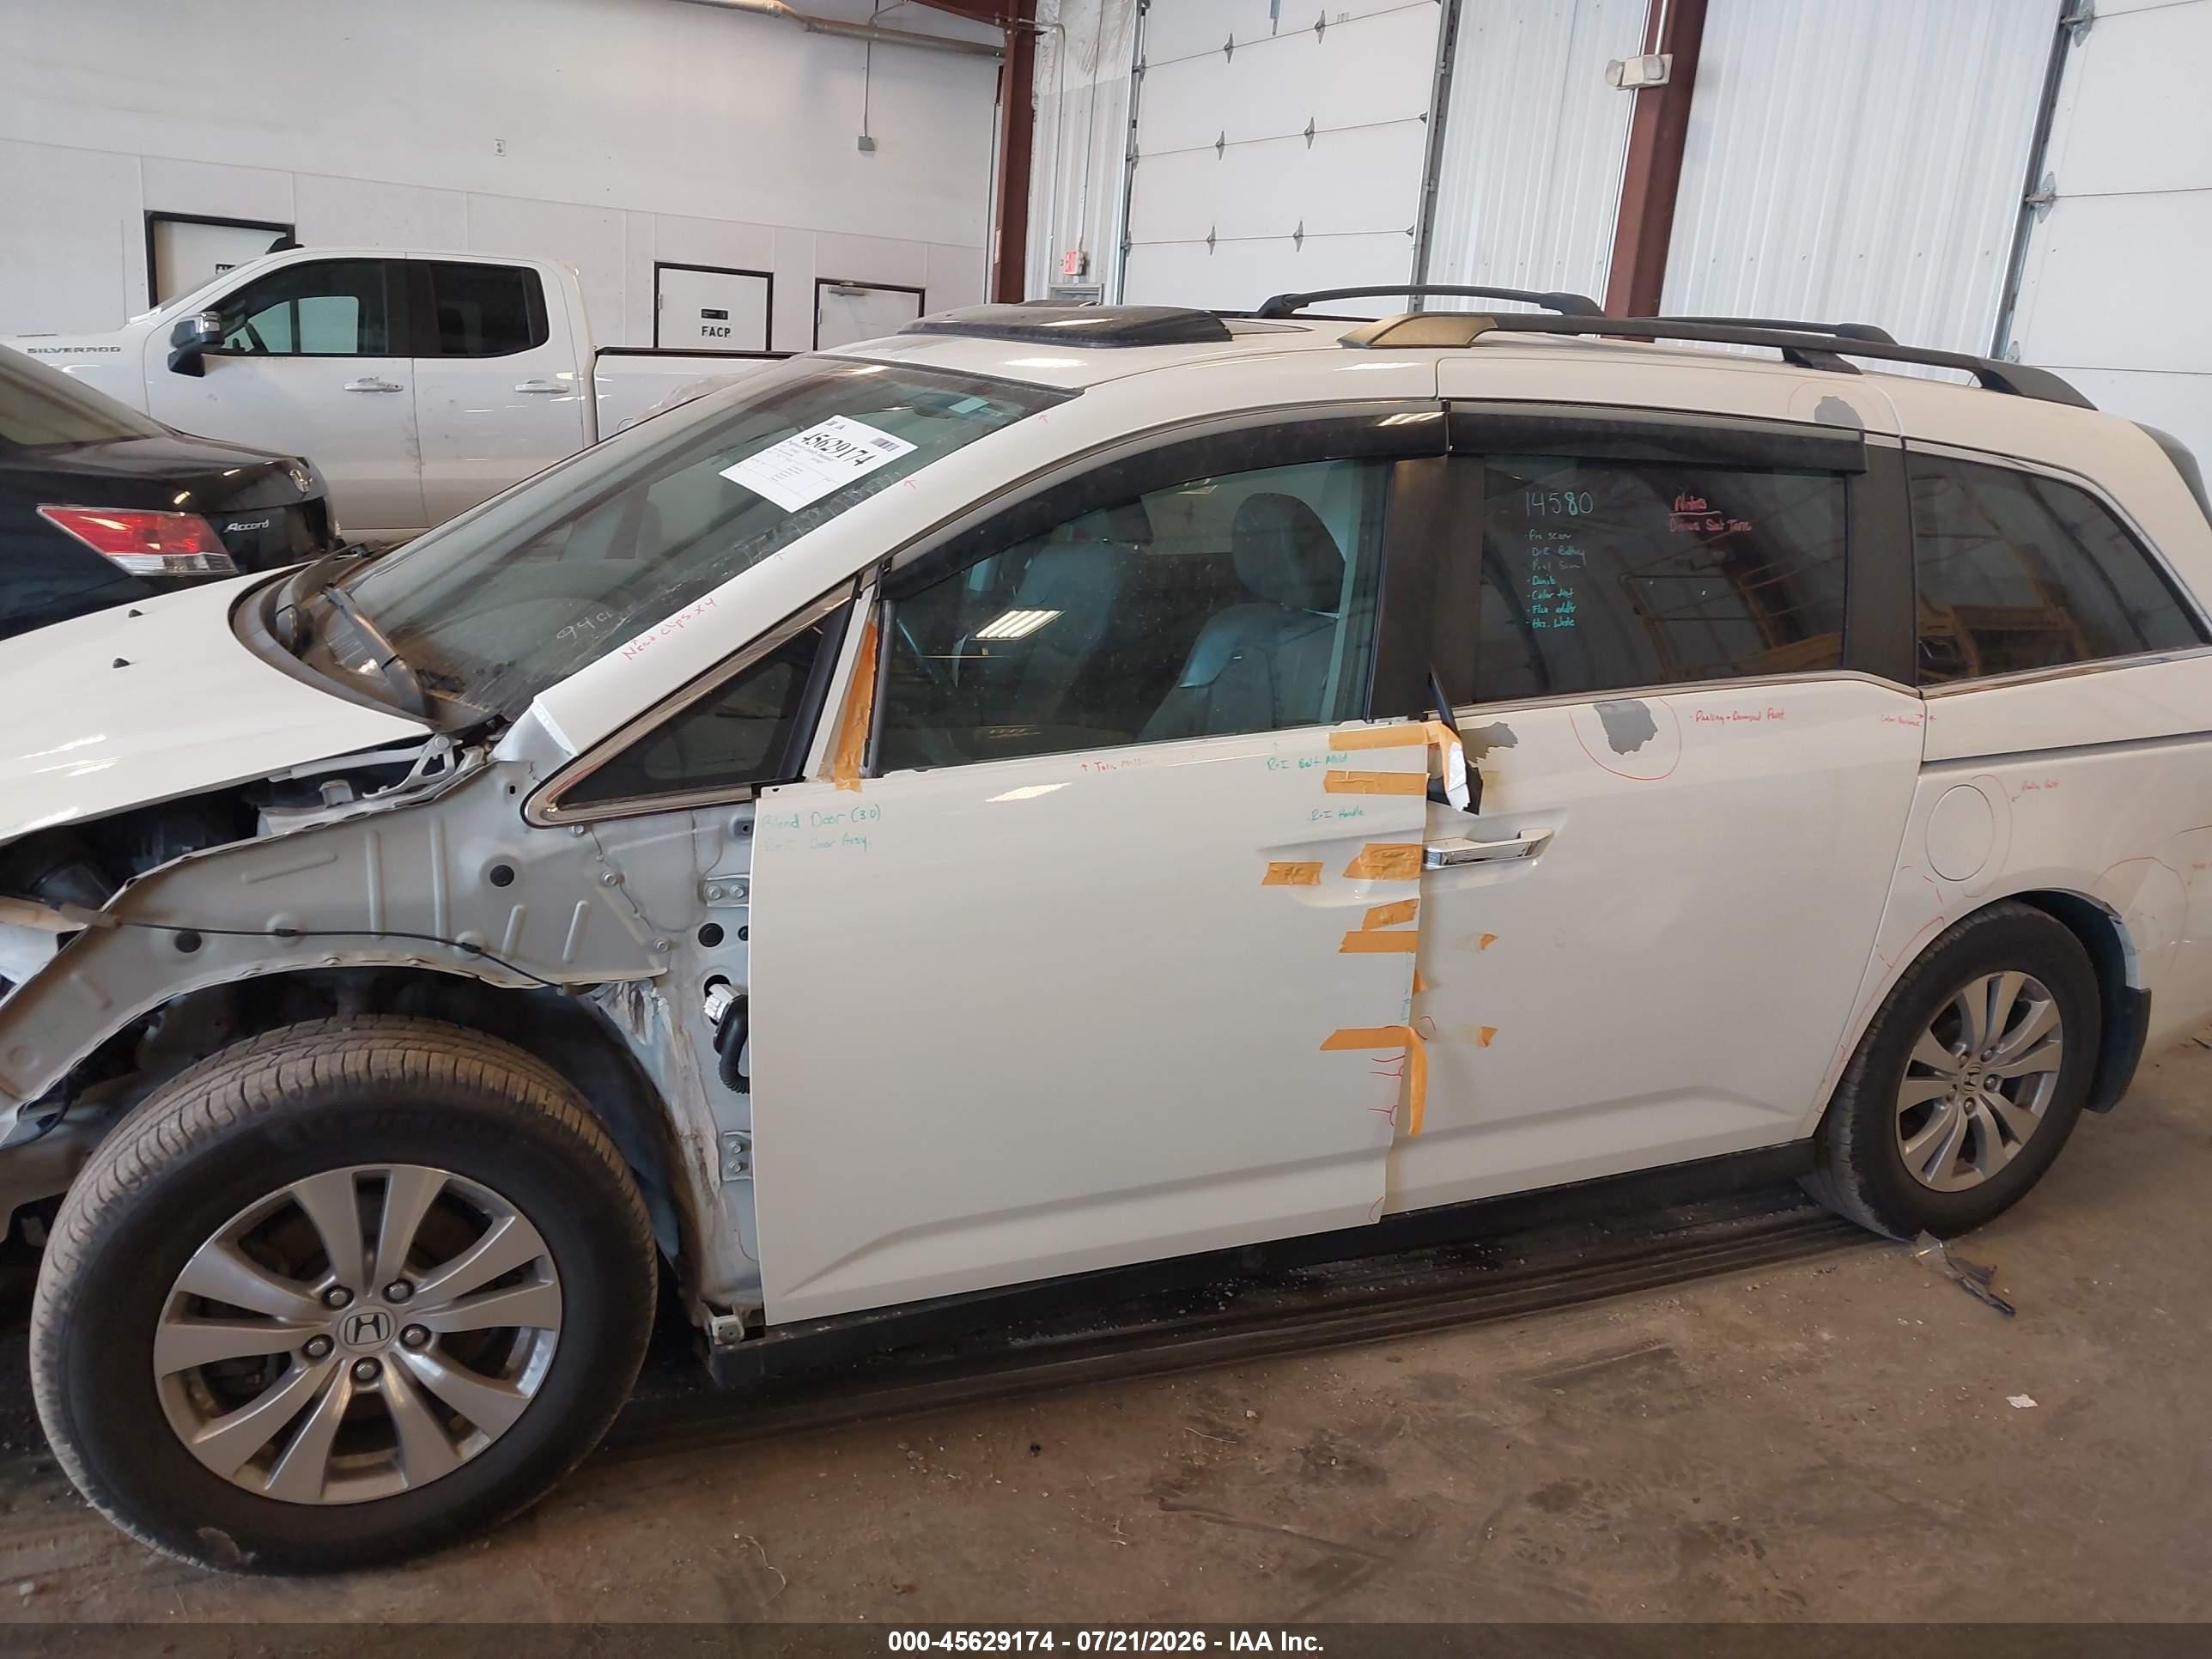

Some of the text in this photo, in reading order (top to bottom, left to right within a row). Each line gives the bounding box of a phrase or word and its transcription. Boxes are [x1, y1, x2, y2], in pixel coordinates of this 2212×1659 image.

[701, 325, 732, 337] FACP
[800, 432, 877, 466] 45629174
[1525, 491, 1594, 517] 14580
[223, 519, 270, 533] Accord
